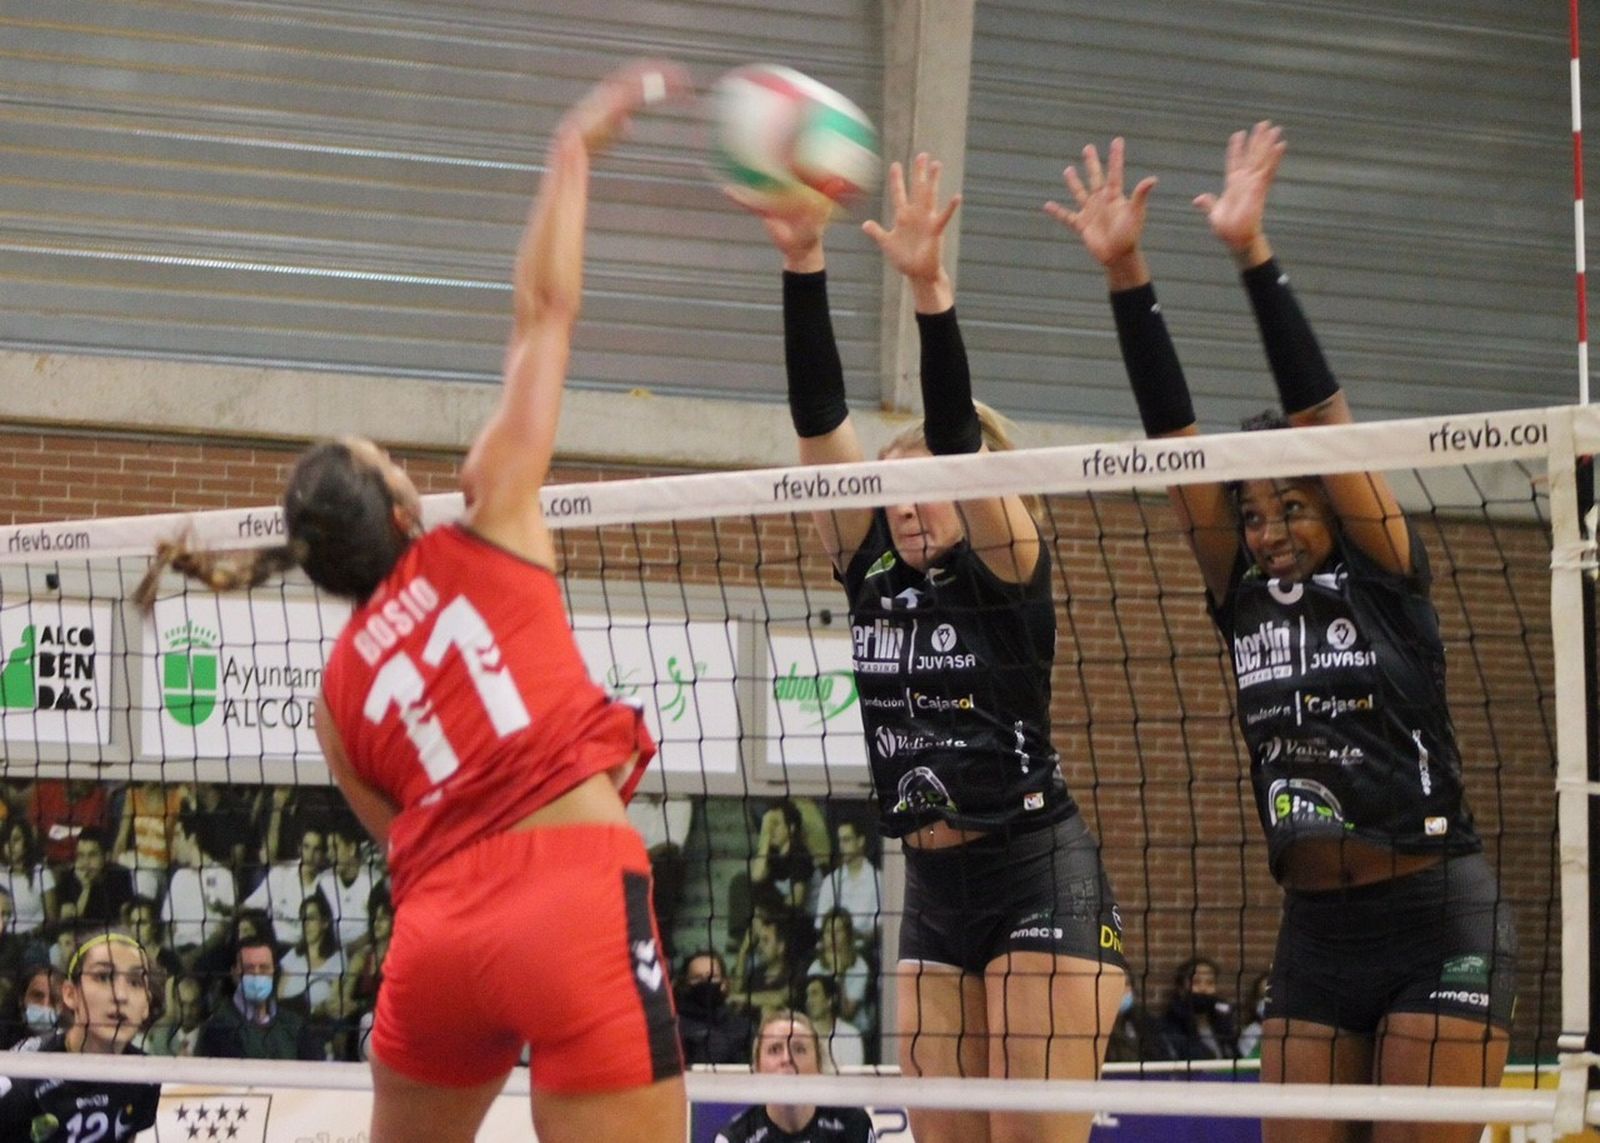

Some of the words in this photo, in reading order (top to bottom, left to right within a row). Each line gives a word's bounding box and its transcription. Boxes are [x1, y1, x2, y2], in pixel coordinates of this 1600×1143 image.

[1081, 447, 1206, 477] rfevb.com
[772, 472, 882, 502] rfevb.com
[544, 495, 592, 518] .com
[8, 528, 90, 552] rfevb.com
[39, 626, 95, 648] ALCO
[851, 618, 904, 659] erlin
[1234, 620, 1292, 675] berlin
[38, 653, 95, 680] BEN
[916, 654, 976, 670] JUVASA
[37, 685, 94, 711] DAS
[362, 593, 532, 786] 11
[914, 692, 975, 712] Cajasol
[66, 1110, 109, 1143] 12
